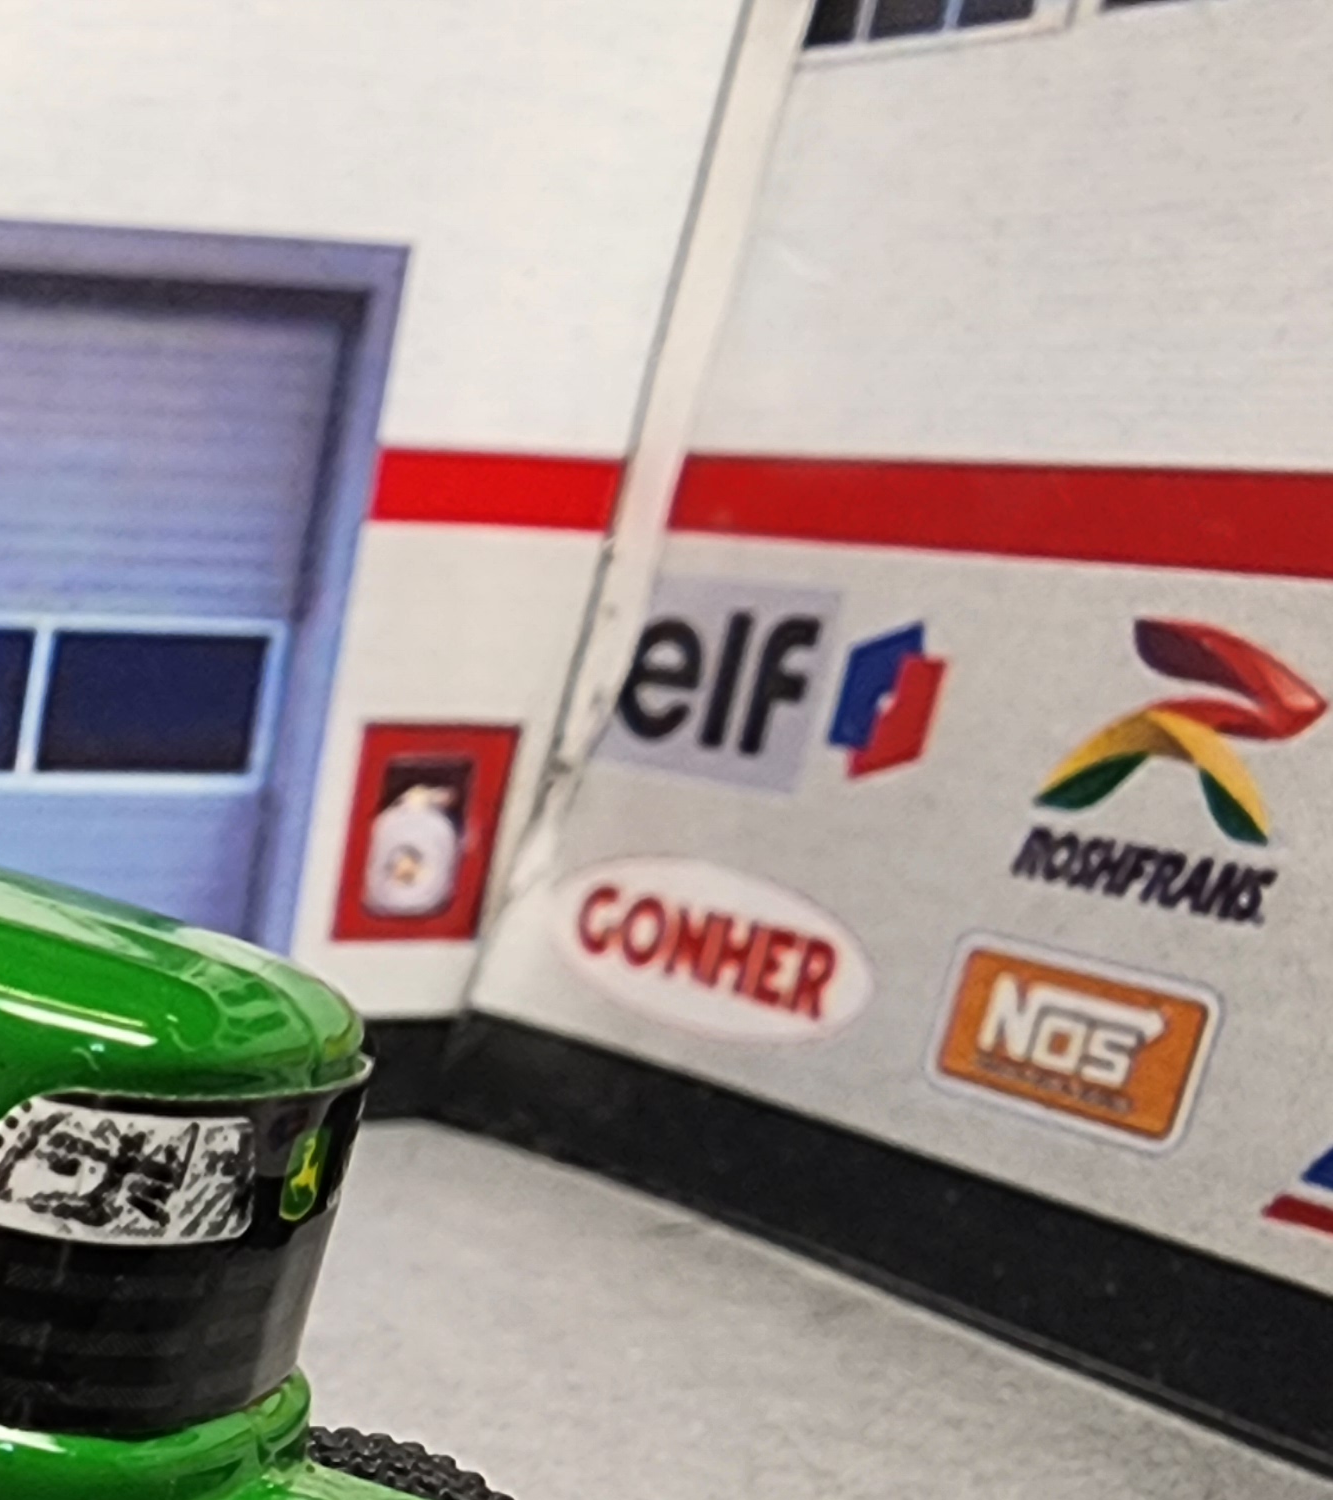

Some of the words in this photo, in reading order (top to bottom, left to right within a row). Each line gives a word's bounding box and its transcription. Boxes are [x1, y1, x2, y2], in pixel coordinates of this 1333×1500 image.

[618, 611, 821, 756] elf
[1011, 827, 1278, 924] ROSHFRANS
[977, 971, 1165, 1089] NOS
